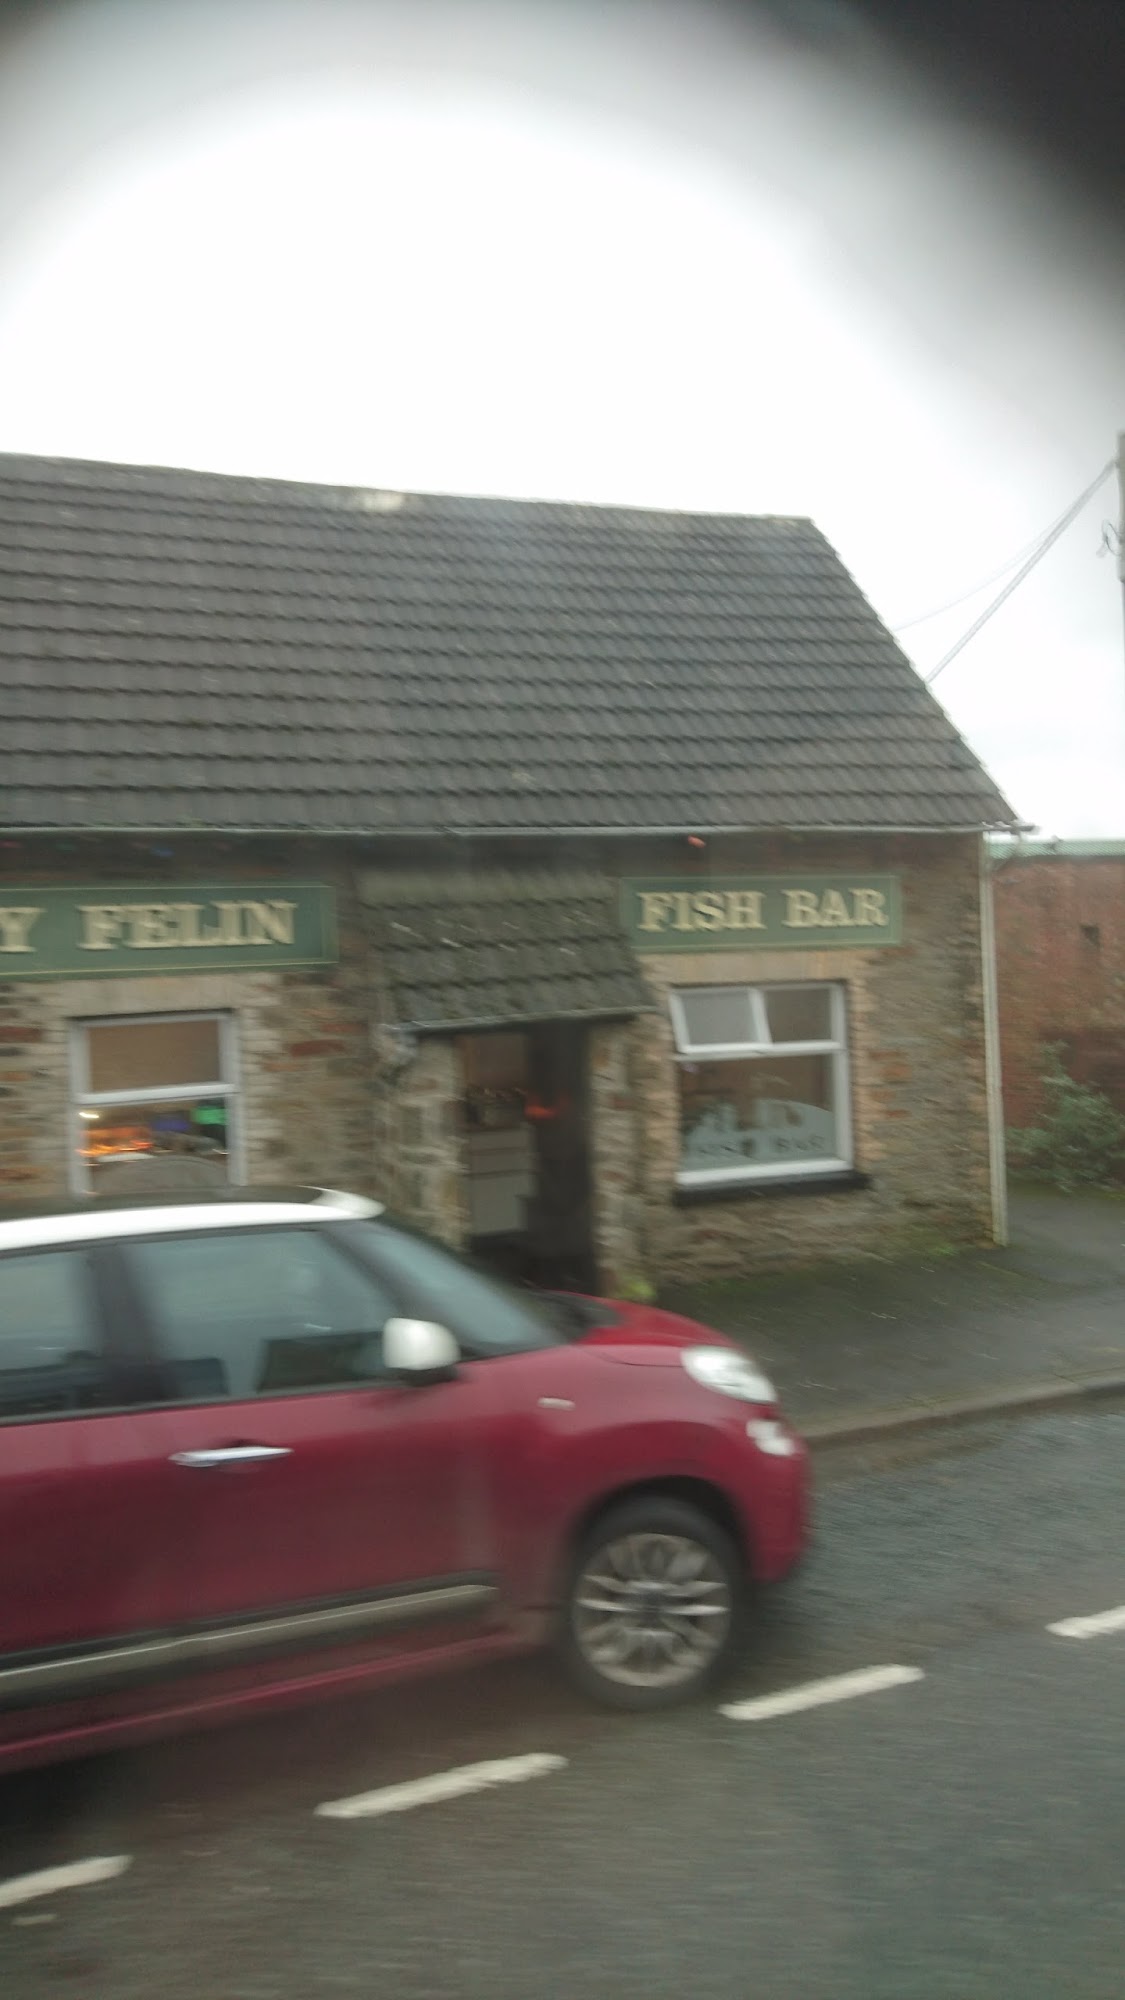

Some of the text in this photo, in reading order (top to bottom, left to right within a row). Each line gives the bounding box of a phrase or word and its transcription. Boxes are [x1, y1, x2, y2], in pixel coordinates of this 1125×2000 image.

[0, 900, 297, 952] Y FELIN
[636, 888, 889, 932] FISH BAR
